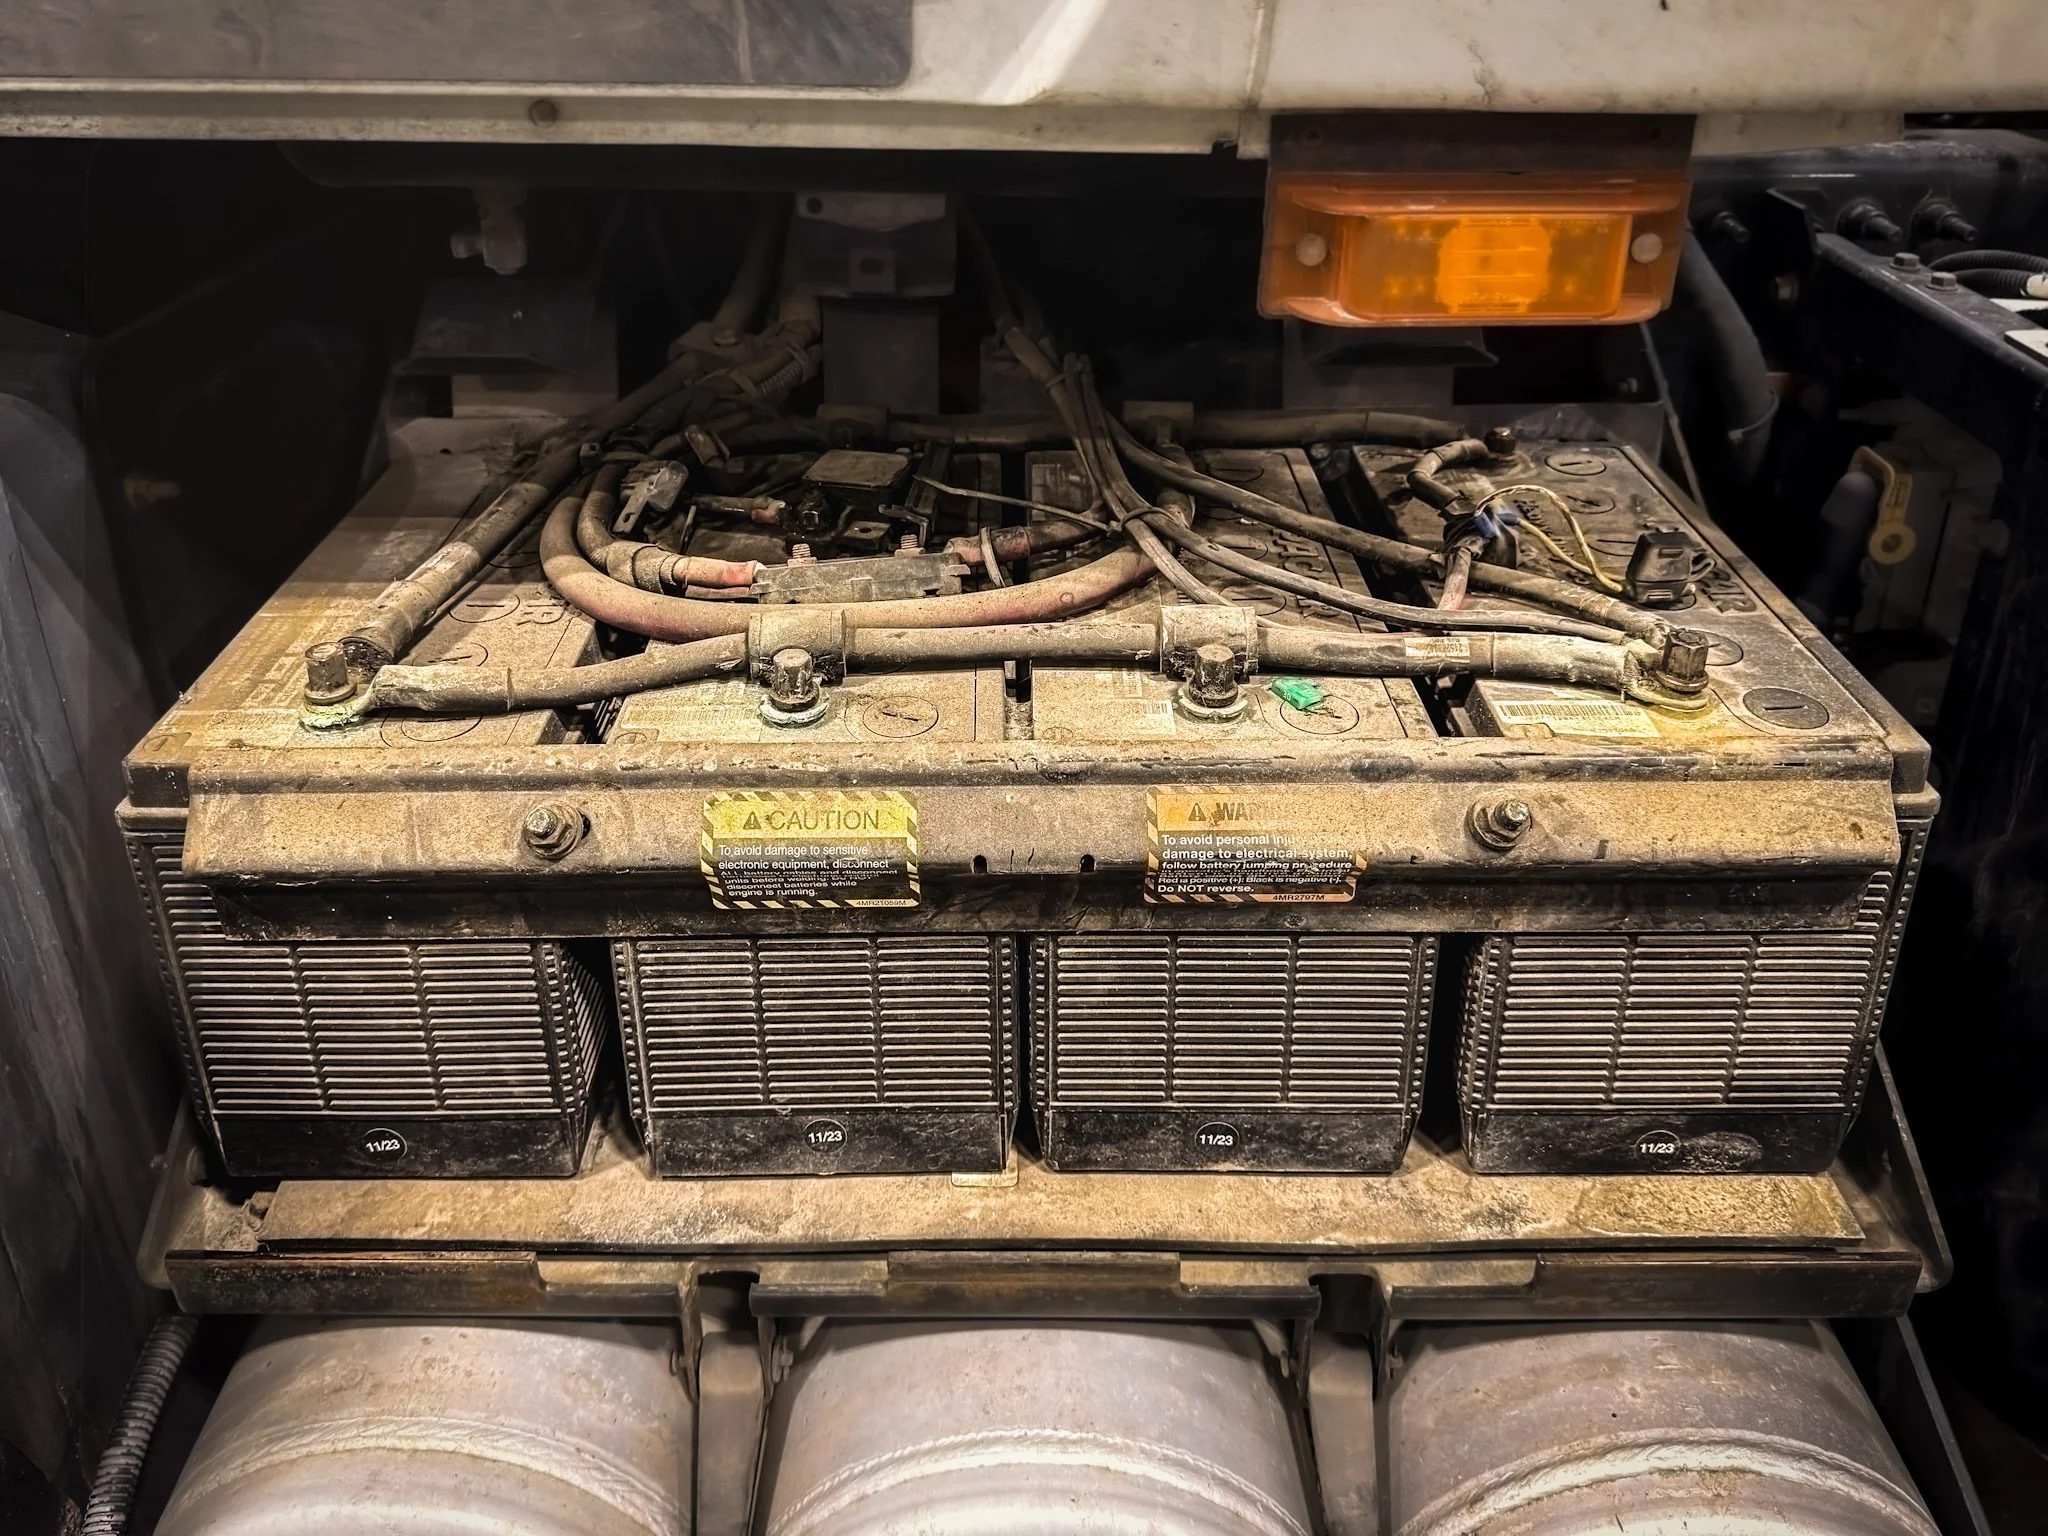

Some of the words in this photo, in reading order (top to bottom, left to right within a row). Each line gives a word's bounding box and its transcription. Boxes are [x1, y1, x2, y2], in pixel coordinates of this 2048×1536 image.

[768, 810, 879, 830] CAUTION
[1162, 834, 1176, 845] To
[1179, 834, 1213, 845] avoid
[1216, 834, 1270, 848] personal
[718, 845, 731, 856] To
[734, 844, 763, 855] avoid
[764, 844, 807, 858] damage
[810, 845, 820, 855] to
[822, 844, 868, 855] sensitive
[1162, 849, 1214, 861] damage
[1218, 849, 1232, 859] to
[1235, 849, 1297, 859] electrical
[1302, 849, 1353, 861] system,
[718, 859, 769, 870] electronic
[772, 859, 830, 871] equipment,
[832, 858, 889, 869] disconnect
[1162, 861, 1198, 869] follow
[1200, 861, 1241, 870] battery
[1242, 860, 1288, 870] jumping
[1294, 861, 1352, 870] prcedure
[1189, 876, 1228, 885] positive
[1285, 876, 1328, 885] negative
[728, 889, 763, 898] engine
[776, 888, 818, 897] running.
[1157, 884, 1174, 893] Do
[1177, 884, 1204, 893] NOT
[1207, 884, 1254, 893] reverse.
[808, 1130, 843, 1144] 11/23
[1199, 1133, 1234, 1147] 11/23
[365, 1139, 401, 1153] 11/23
[1639, 1142, 1675, 1154] 11/23
